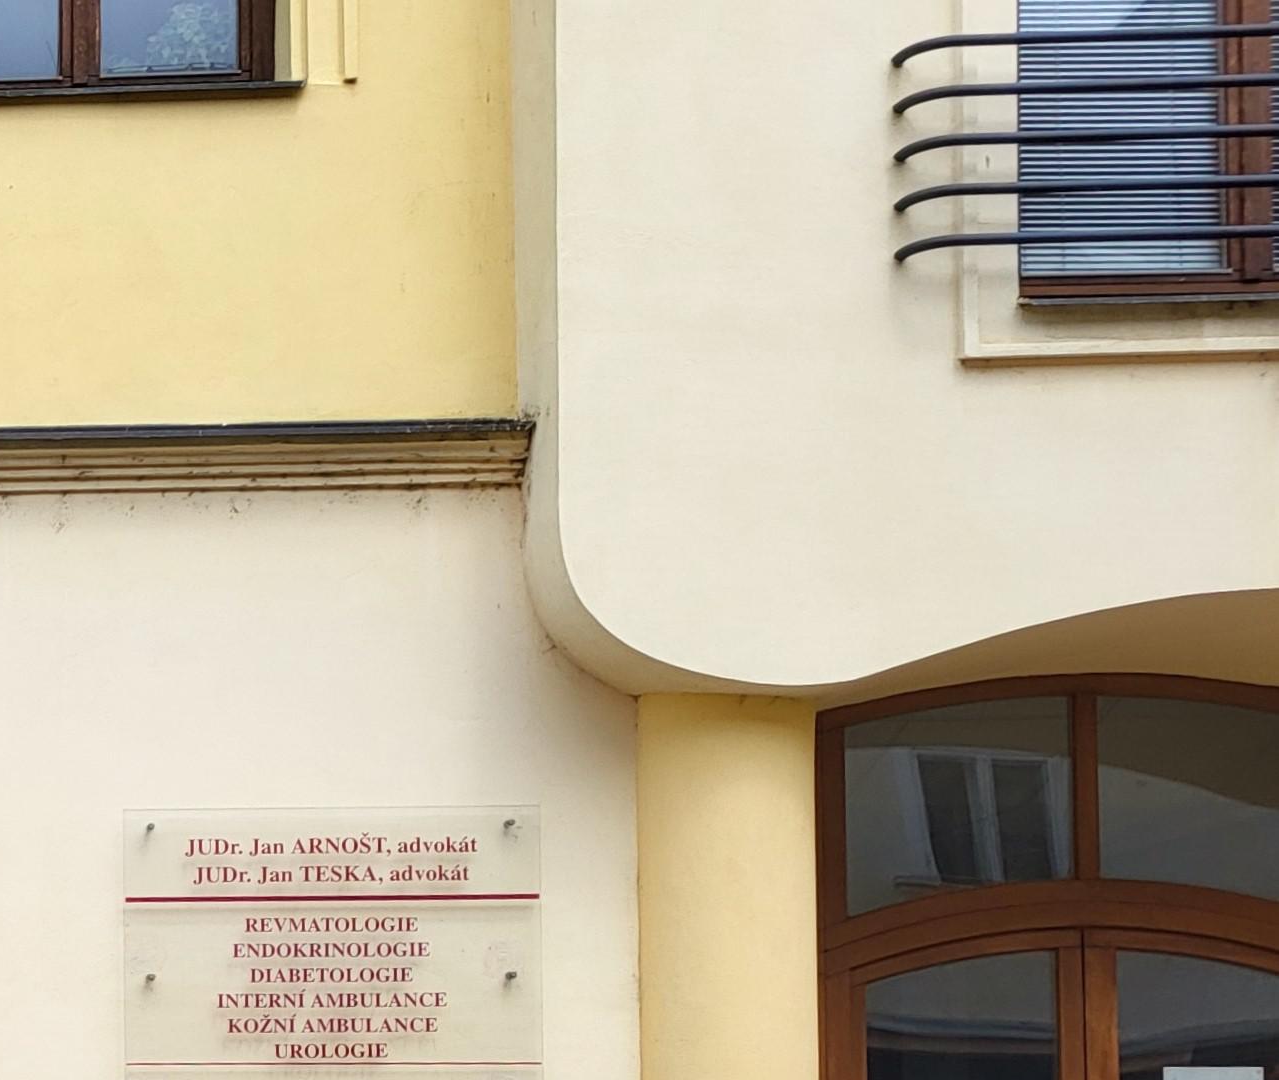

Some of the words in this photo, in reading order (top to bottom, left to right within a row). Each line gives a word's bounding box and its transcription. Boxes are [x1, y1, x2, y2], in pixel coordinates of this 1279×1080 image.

[185, 838, 243, 857] JUDr.
[249, 838, 284, 857] Jan
[291, 832, 392, 857] ARNOŠT,
[397, 837, 478, 854] advokát
[193, 866, 251, 885] JUDr.
[257, 866, 293, 884] Jan
[299, 865, 384, 885] TESKA,
[389, 864, 470, 882] advokát
[244, 917, 419, 933] REVMATOLOGIE
[232, 941, 430, 958] ENDOKRINOLOGIE
[250, 967, 413, 983] DIABETOLOGIE
[217, 989, 307, 1009] INTERNÍ
[311, 991, 448, 1008] AMBULANCE
[227, 1014, 295, 1034] KOŽNÍ
[301, 1017, 438, 1034] AMBULANCE
[274, 1043, 388, 1059] UROLOGIE
